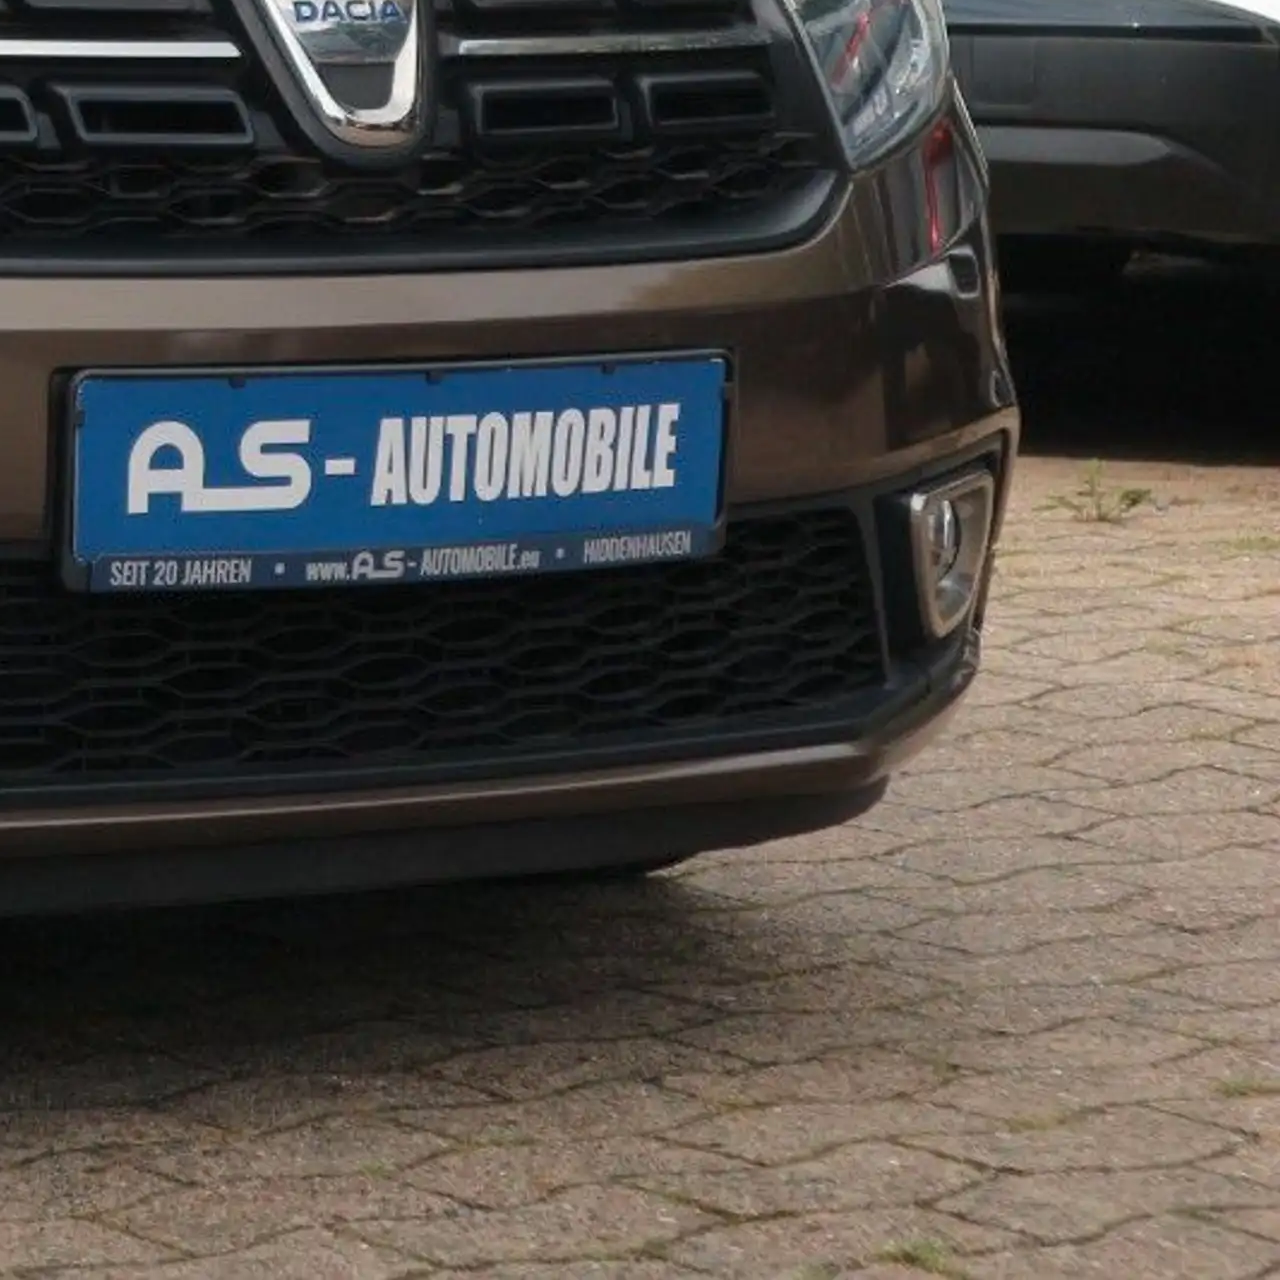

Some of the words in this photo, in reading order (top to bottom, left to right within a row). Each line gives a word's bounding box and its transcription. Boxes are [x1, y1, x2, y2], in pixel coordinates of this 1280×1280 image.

[293, 0, 407, 24] DACIA
[109, 561, 149, 587] SEIT
[152, 561, 178, 586] 20
[181, 557, 253, 585] JAHREN
[583, 529, 693, 564] HIDDENHAUSEN
